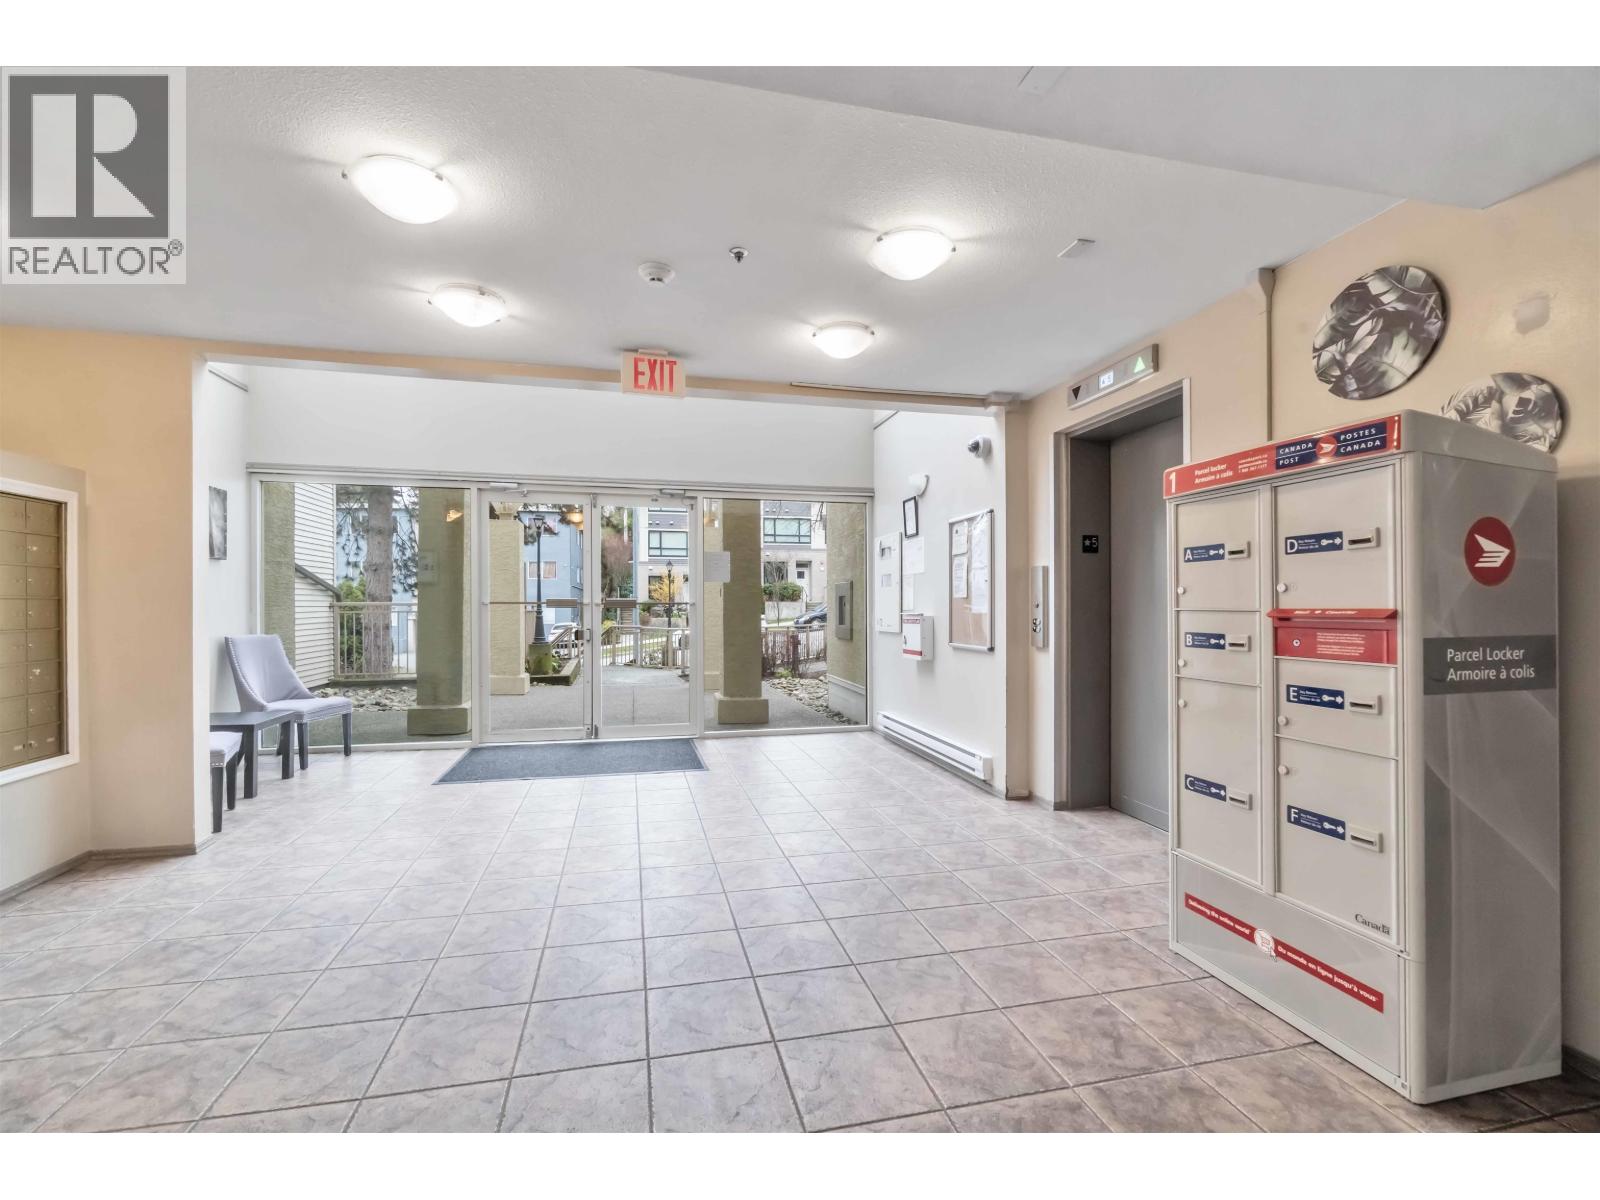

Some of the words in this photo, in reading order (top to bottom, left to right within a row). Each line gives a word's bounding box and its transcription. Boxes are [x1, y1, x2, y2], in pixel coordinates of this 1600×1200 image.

[634, 357, 677, 393] EXIT
[1340, 427, 1376, 441] POSTES
[1279, 442, 1313, 454] CANADA
[1340, 439, 1381, 453] CANADA
[1279, 456, 1299, 466] POST
[1194, 466, 1210, 476] Parcel
[1169, 471, 1176, 494] 1
[1287, 539, 1298, 553] D
[1184, 549, 1193, 561] A
[1186, 634, 1193, 646] B
[1446, 647, 1483, 662] Parcel
[1486, 646, 1525, 660] Locker
[1446, 666, 1497, 682] Armoire
[1499, 665, 1507, 680] à
[1509, 664, 1535, 679] colis
[1290, 687, 1298, 702] E
[1186, 777, 1194, 790] C
[1291, 808, 1299, 822] F
[1355, 913, 1391, 936] Canada
[1286, 951, 1307, 966] monde
[1308, 962, 1317, 970] en
[1317, 965, 1333, 979] ligne
[1333, 975, 1358, 992] jusqu'à
